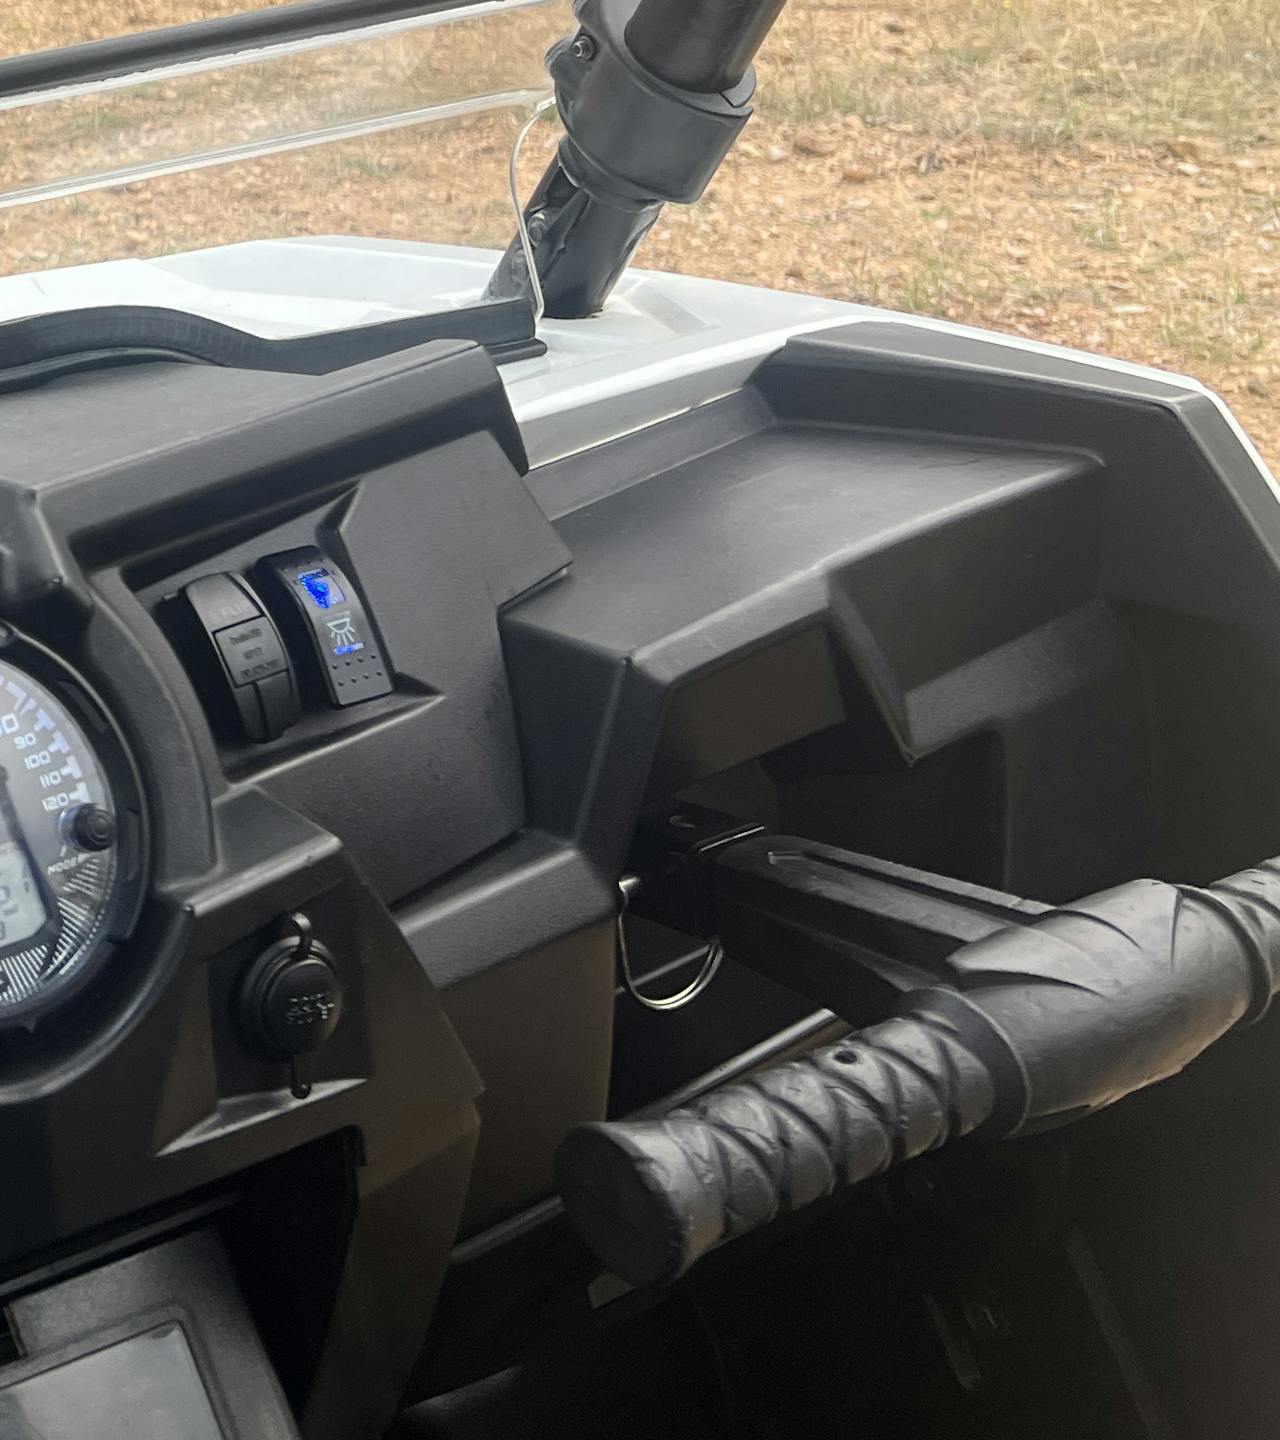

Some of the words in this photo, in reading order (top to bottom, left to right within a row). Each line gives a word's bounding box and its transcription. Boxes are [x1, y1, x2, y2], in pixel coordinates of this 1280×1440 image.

[14, 732, 37, 749] 90
[24, 750, 50, 770] 100
[40, 771, 61, 788] 110
[42, 792, 69, 812] 120
